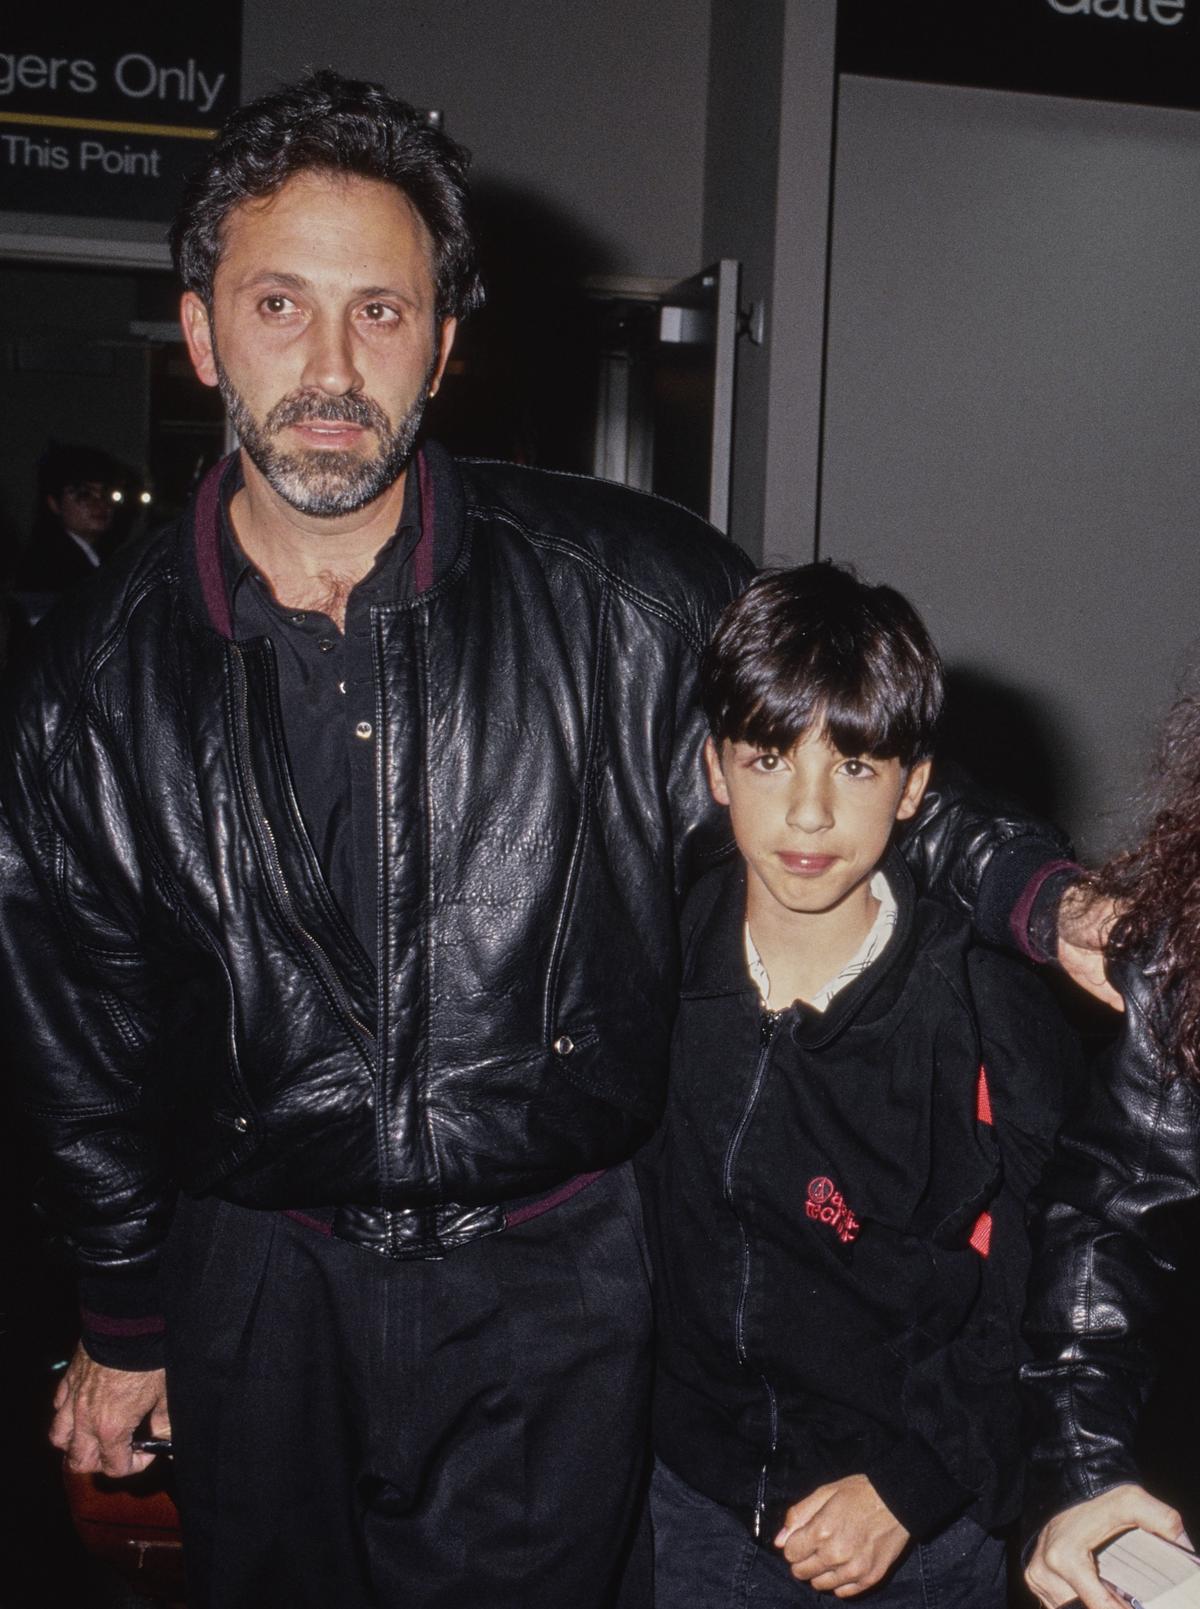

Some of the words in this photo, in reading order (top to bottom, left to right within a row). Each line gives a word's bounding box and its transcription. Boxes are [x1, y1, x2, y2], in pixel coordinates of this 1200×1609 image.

[115, 53, 225, 112] Only
[1, 134, 70, 169] This
[80, 141, 161, 177] Point
